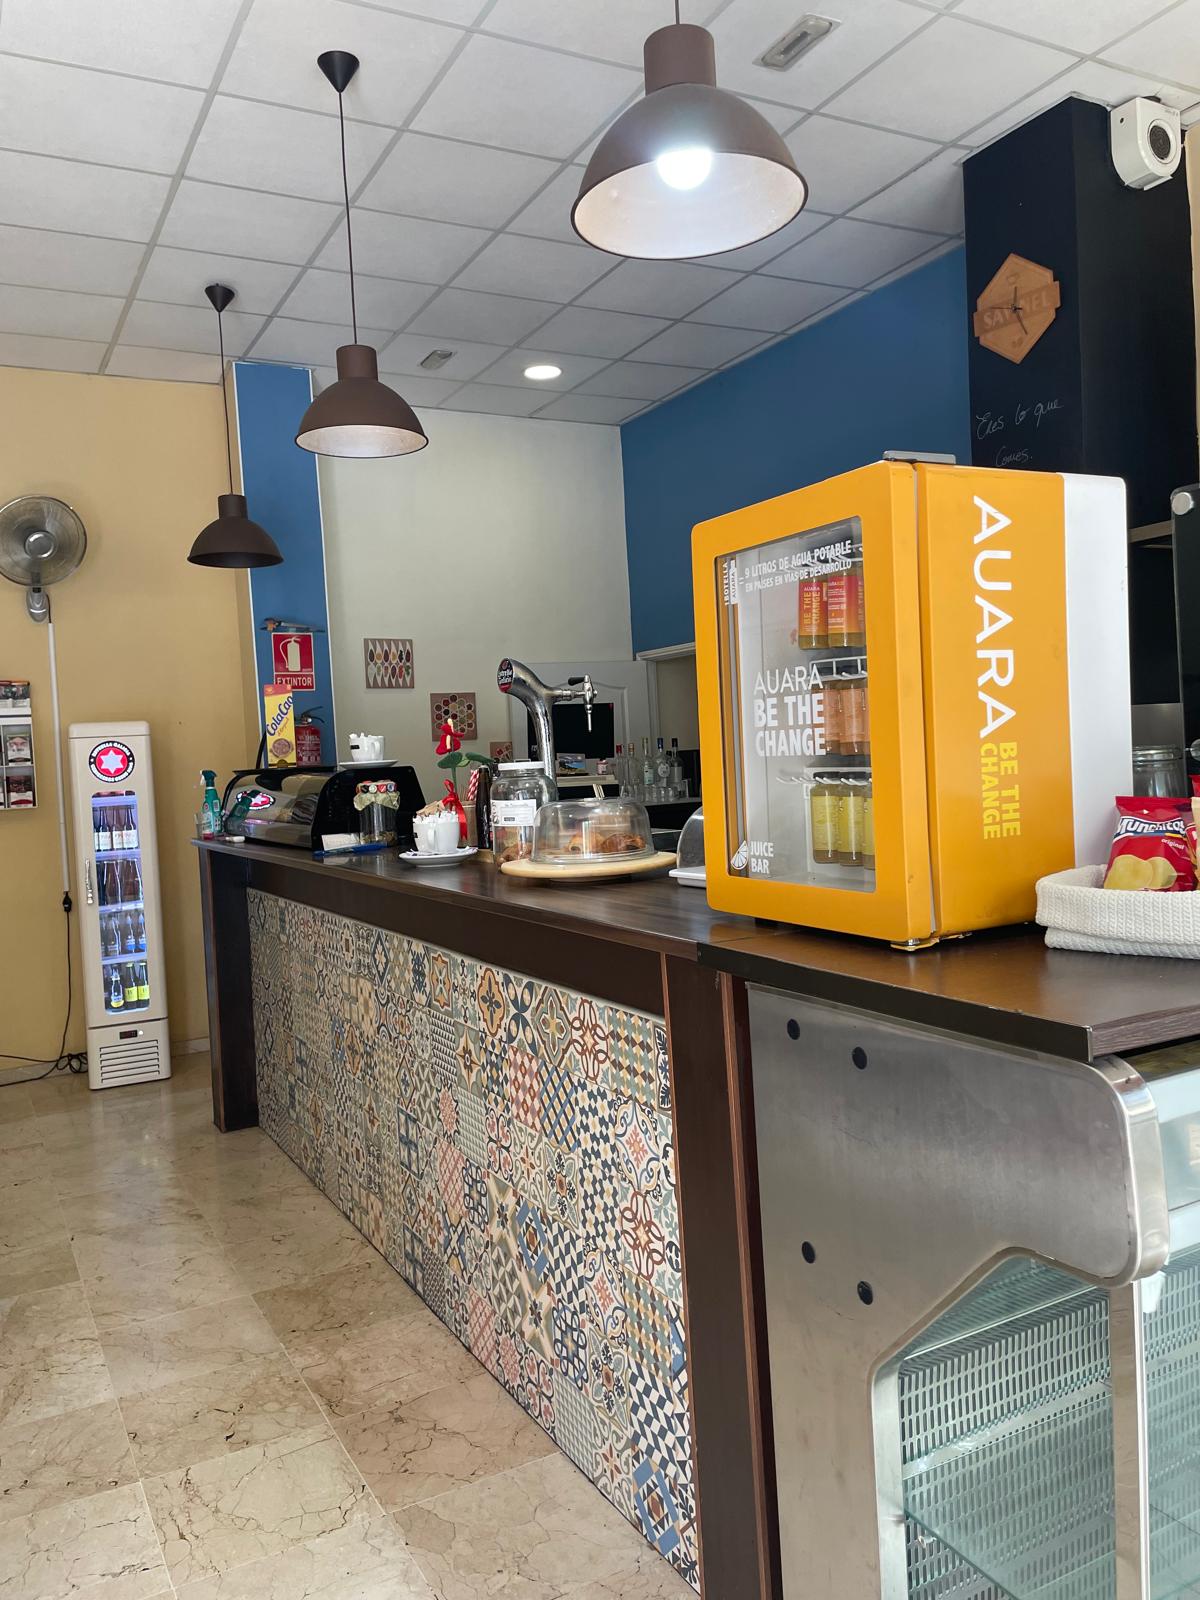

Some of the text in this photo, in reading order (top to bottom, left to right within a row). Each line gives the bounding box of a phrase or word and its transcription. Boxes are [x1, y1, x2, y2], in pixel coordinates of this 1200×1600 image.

[1034, 399, 1064, 428] que
[744, 540, 852, 578] 9 LITROS DE AGUA POTABLE
[774, 575, 783, 586] EN
[799, 569, 809, 580] DE
[810, 558, 852, 578] DESARROLLO
[973, 495, 1016, 739] AUARA
[277, 677, 312, 687] EXTINTOR
[753, 663, 824, 695] AUARA
[753, 693, 825, 728] BE THE
[755, 727, 826, 757] CHANGE
[980, 742, 1001, 840] CHANGE
[1000, 741, 1021, 837] BE THE
[750, 840, 774, 857] JUICE
[751, 858, 770, 874] BAR
